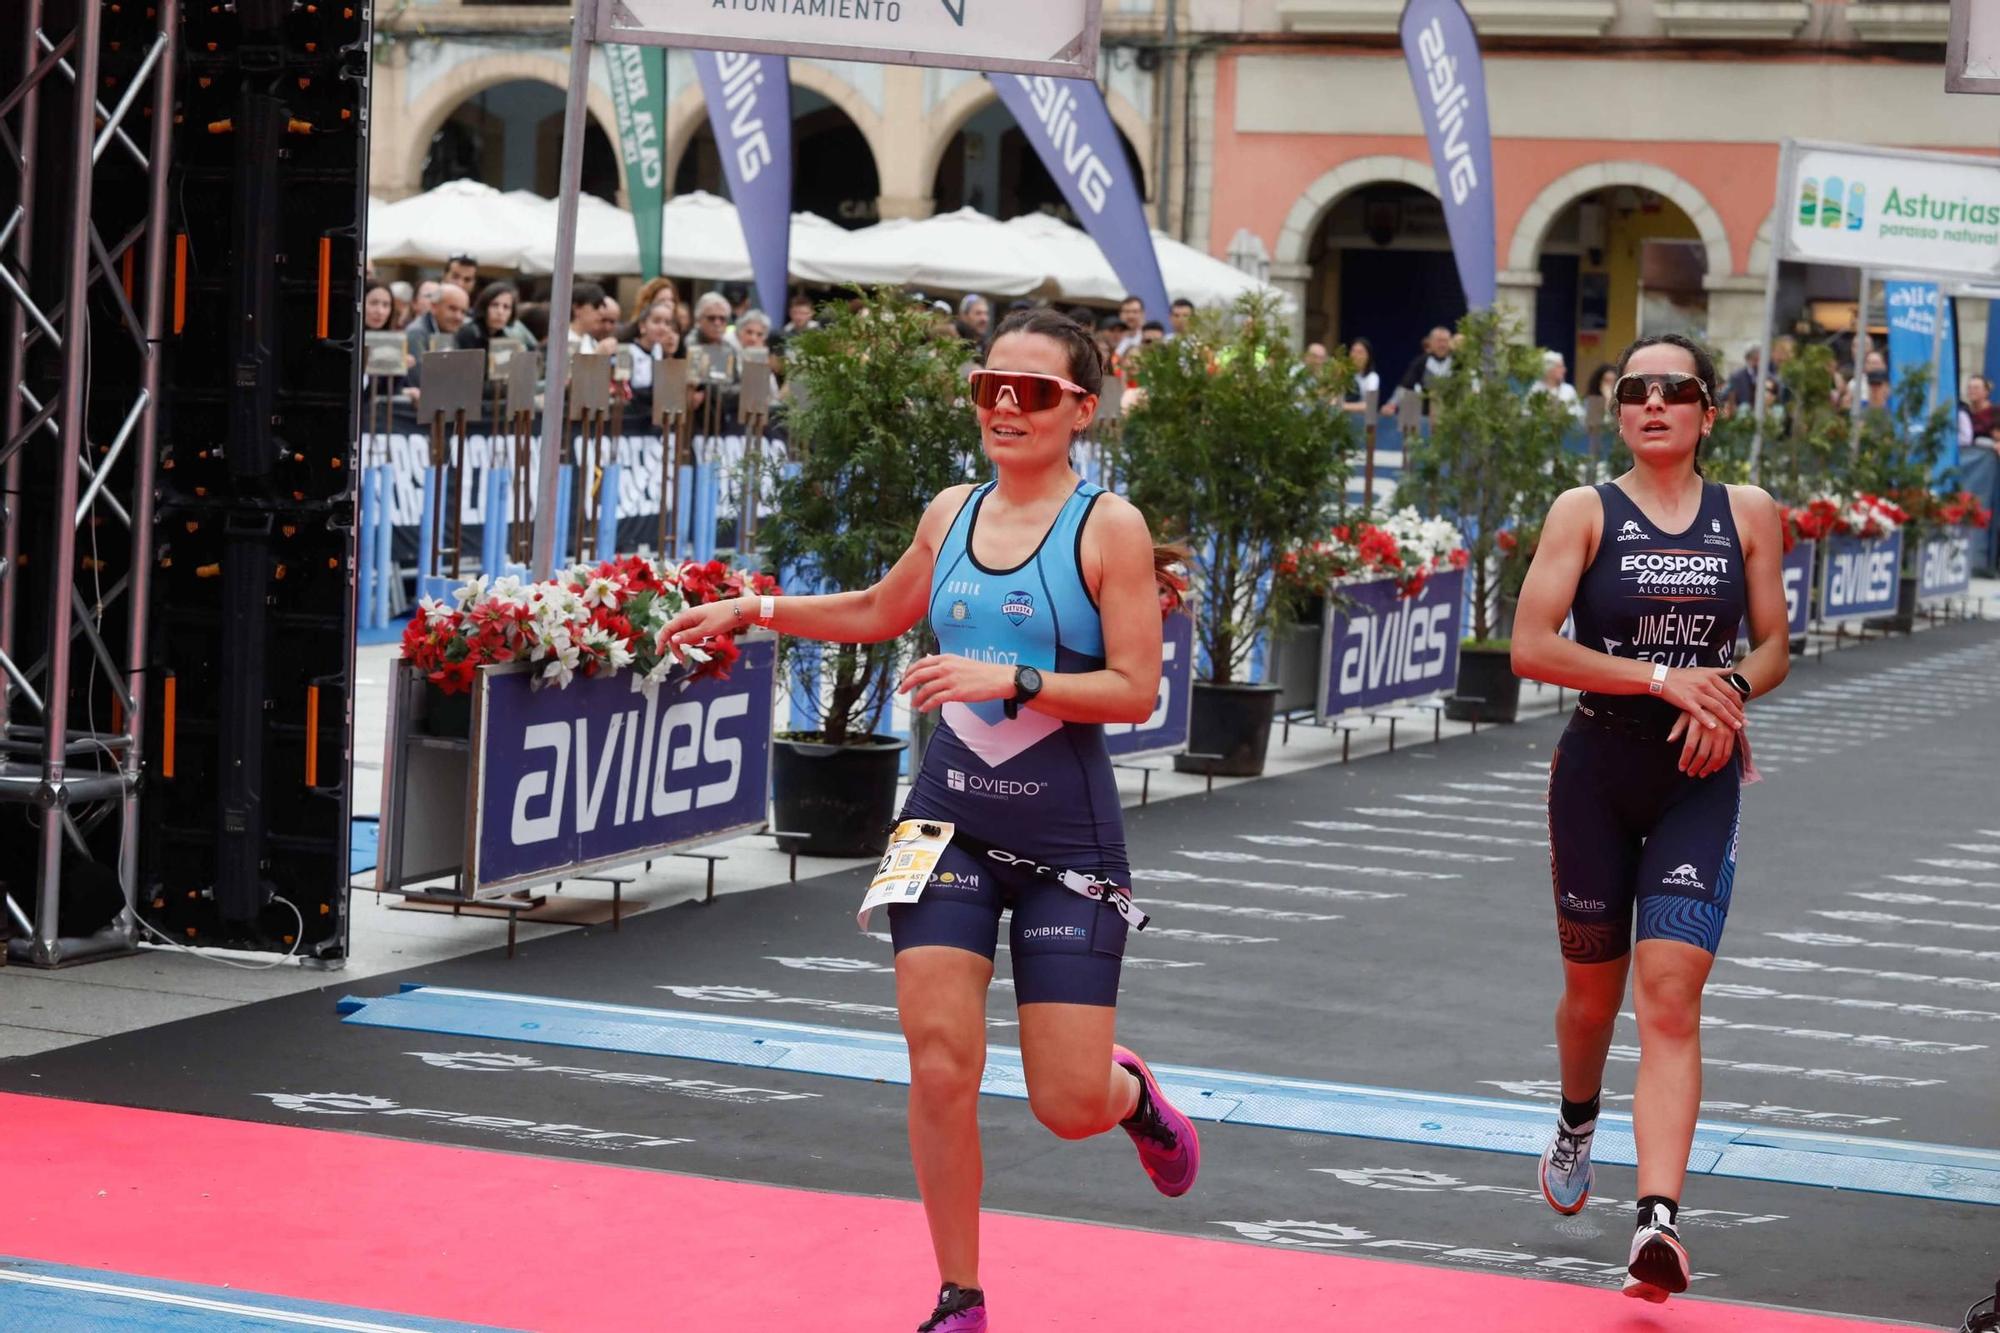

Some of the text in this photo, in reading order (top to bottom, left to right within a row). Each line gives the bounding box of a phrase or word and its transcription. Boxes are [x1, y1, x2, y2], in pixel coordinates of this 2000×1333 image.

[1882, 186, 2000, 225] Asturias
[1943, 229, 1998, 245] natural
[1621, 554, 1728, 574] ECOSPORT
[1637, 570, 1719, 586] triatlón
[1639, 586, 1717, 595] ALCOBENDAS
[1004, 603, 1031, 614] VETUSTA
[1632, 606, 1716, 646] JIMÉNEZ
[1339, 587, 1450, 695] avilés
[969, 775, 1040, 795] OVIEDO
